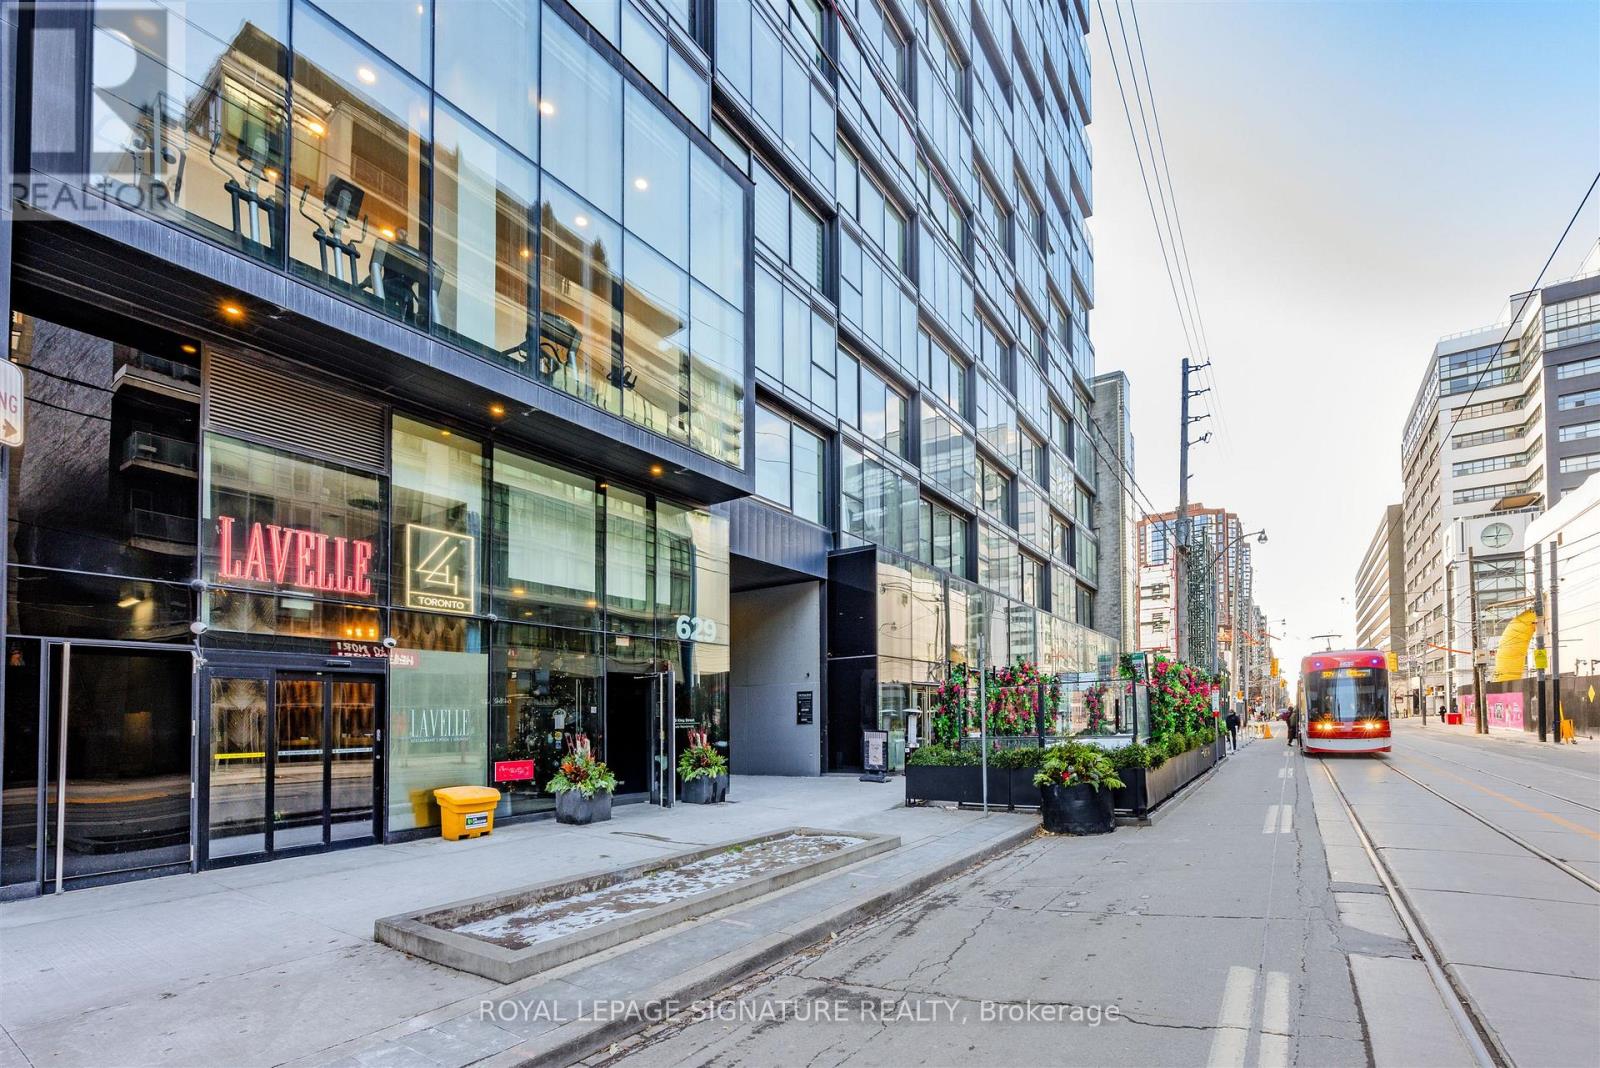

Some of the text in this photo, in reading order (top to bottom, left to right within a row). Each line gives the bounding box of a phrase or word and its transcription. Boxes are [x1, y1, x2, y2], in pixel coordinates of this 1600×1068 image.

[218, 515, 373, 595] LAVELLE
[417, 596, 465, 609] TORONTO
[676, 614, 717, 642] 629
[410, 709, 471, 737] LAVELLE
